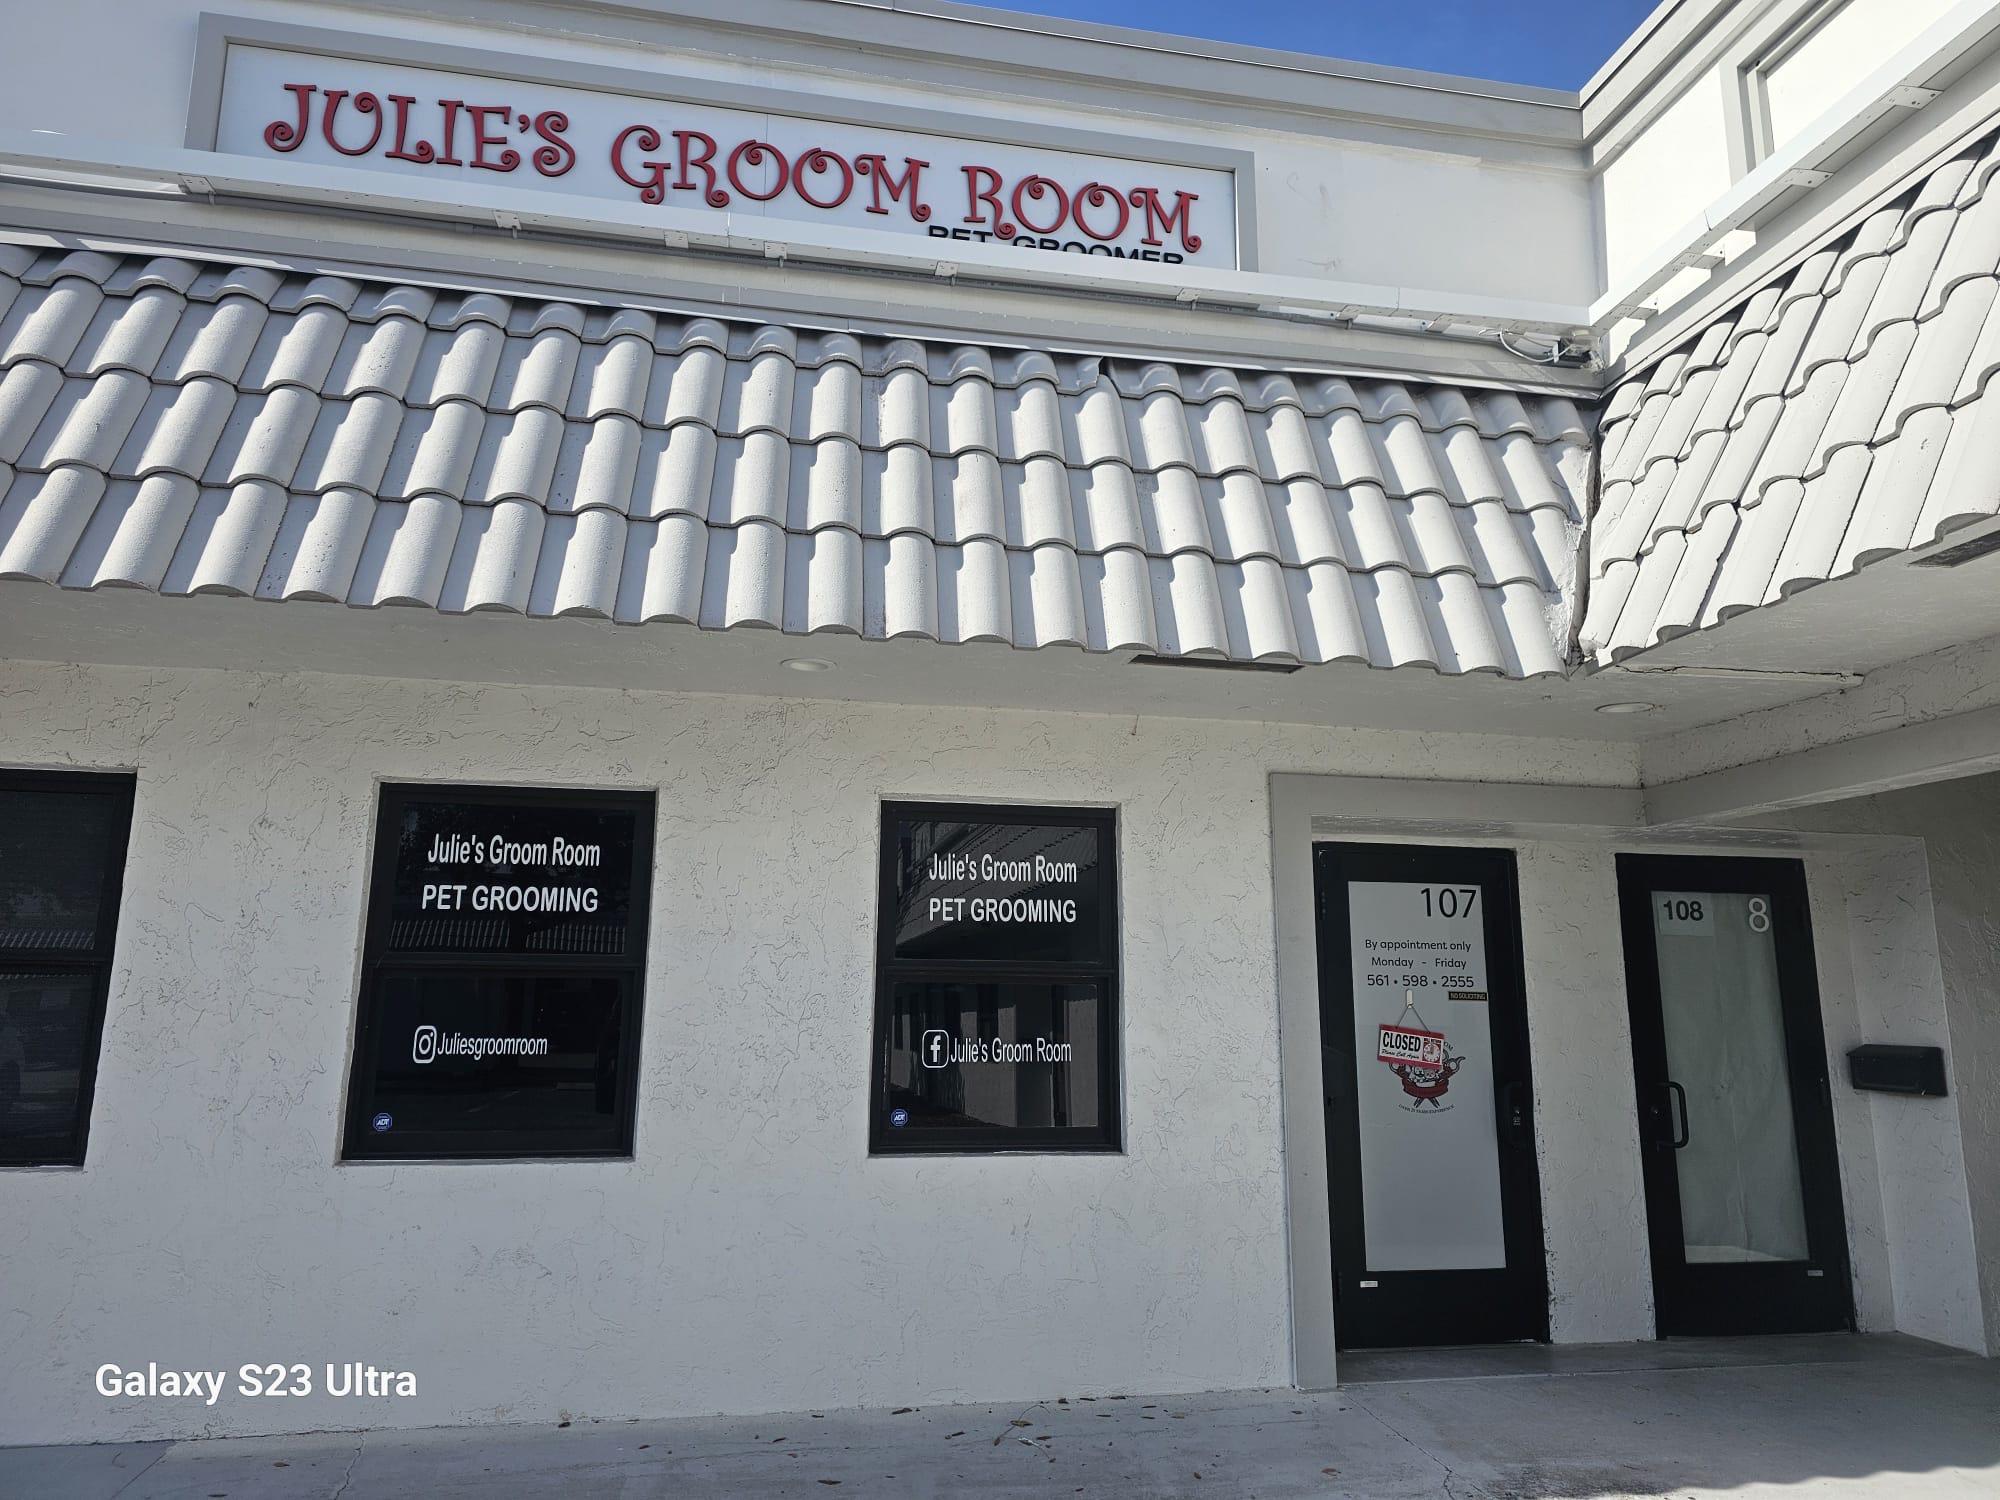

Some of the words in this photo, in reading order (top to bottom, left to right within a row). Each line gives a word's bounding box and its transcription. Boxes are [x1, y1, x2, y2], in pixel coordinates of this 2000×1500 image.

[264, 84, 576, 177] JULIE'S
[611, 125, 932, 221] GROOM
[961, 166, 1202, 253] ROOM
[427, 833, 485, 864] Julie's
[489, 835, 547, 866] Groom
[551, 836, 601, 867] Room
[928, 853, 977, 881] Julie's
[981, 854, 1031, 882] Groom
[1035, 855, 1077, 883] Room
[421, 884, 467, 911] PET
[471, 885, 599, 913] GROOMING
[929, 897, 966, 922] PET
[970, 898, 1077, 923] GROOMING
[1420, 887, 1477, 919] 107
[1662, 900, 1704, 922] 108
[1748, 897, 1770, 933] 8
[1365, 939, 1378, 951] By
[1380, 939, 1447, 952] appointment
[1449, 940, 1472, 953] only
[1371, 957, 1414, 969] Monday
[1435, 958, 1467, 970] Friday
[1367, 974, 1390, 986] 561
[1402, 974, 1428, 987] 598
[1441, 975, 1475, 988] 2555
[437, 1032, 548, 1061] Juliesgroomroom
[950, 1037, 989, 1062] Julie's
[991, 1038, 1033, 1063] Groom
[1036, 1038, 1072, 1063] Room
[1382, 1031, 1421, 1052] CLOSED
